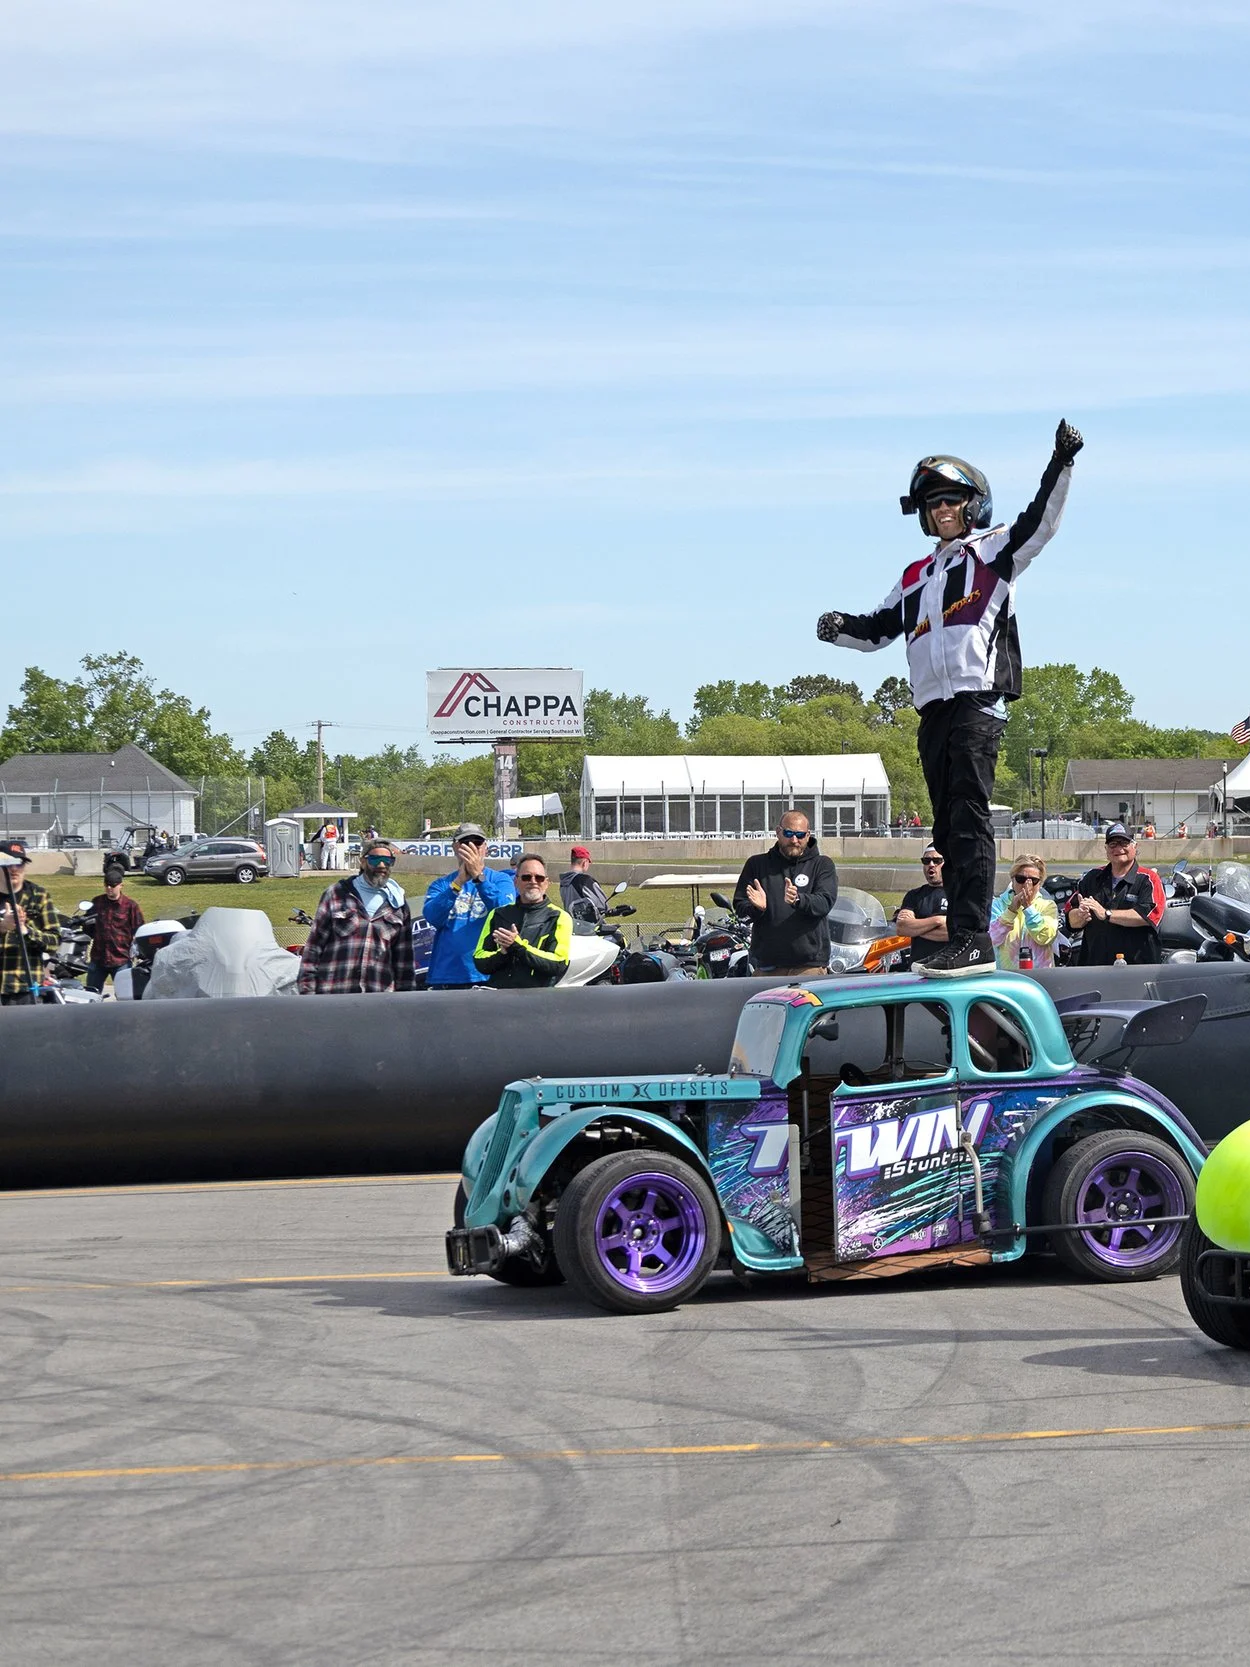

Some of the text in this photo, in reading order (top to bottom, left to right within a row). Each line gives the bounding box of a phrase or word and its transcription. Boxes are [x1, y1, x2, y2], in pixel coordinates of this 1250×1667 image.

[464, 695, 578, 717] CHAPPA
[498, 755, 514, 770] 14
[406, 844, 441, 856] GRB
[487, 845, 523, 858] GRB
[556, 1082, 728, 1098] CUSTOM OFFSETS
